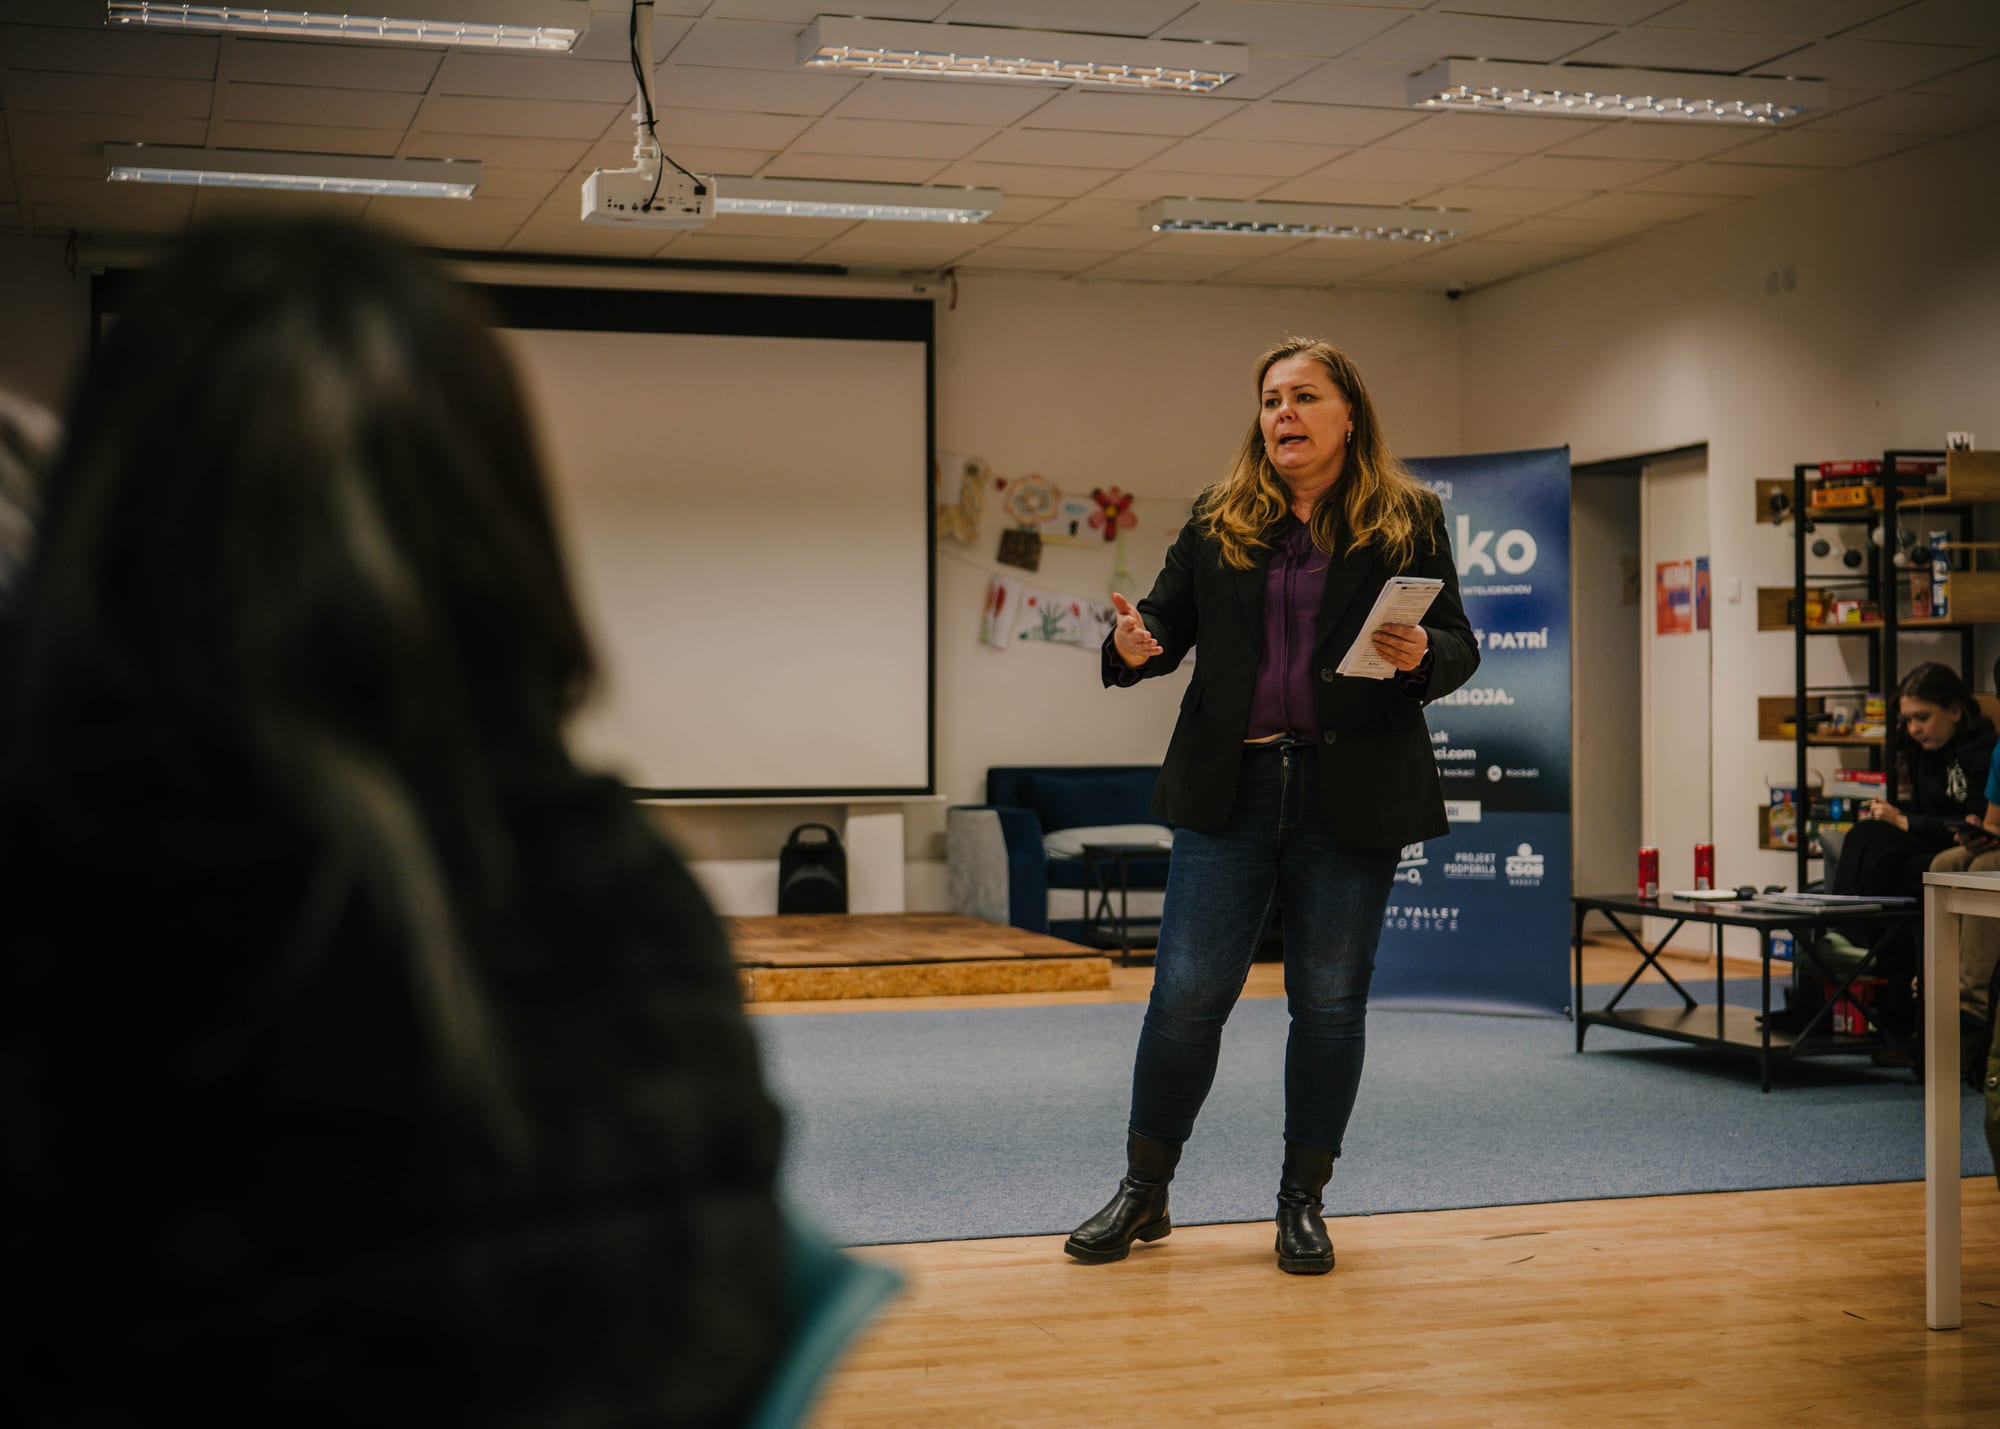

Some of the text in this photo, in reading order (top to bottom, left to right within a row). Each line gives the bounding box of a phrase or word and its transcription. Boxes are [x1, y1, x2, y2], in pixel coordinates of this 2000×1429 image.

[1446, 514, 1538, 576] ko
[1488, 627, 1549, 650] PATRÍ
[1455, 852, 1496, 863] PROJEKT
[1443, 863, 1496, 874] PODPORILA
[1403, 906, 1459, 919] VALLEY
